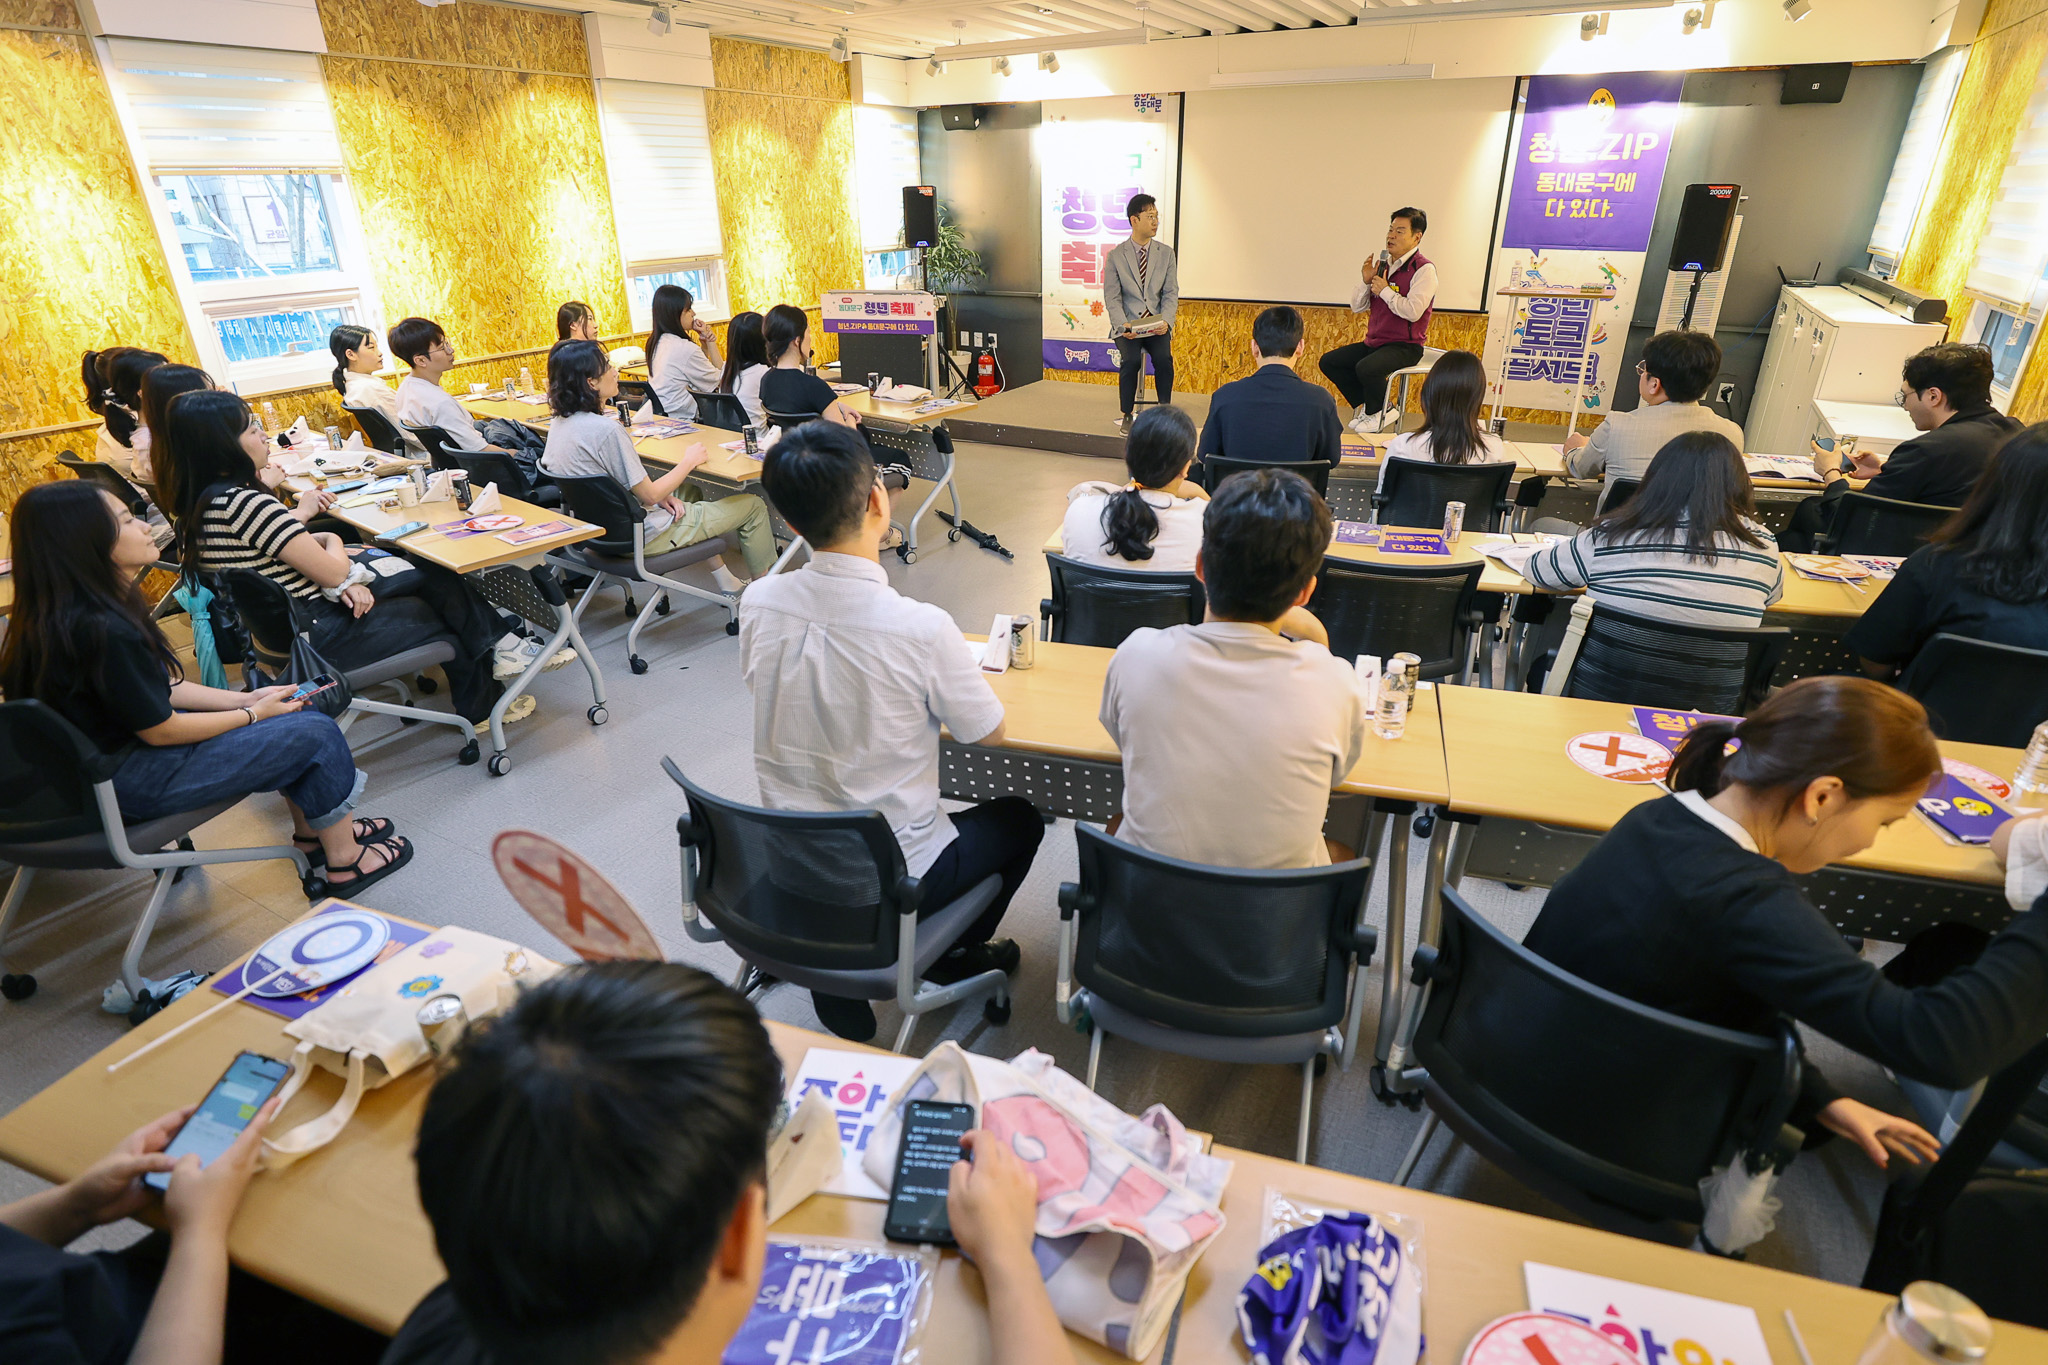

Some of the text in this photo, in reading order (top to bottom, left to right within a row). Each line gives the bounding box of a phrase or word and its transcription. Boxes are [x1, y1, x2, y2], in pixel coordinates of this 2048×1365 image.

[1536, 172, 1637, 193] 동대문구에
[1544, 198, 1614, 218] 다 있다.
[864, 301, 889, 316] 청년
[890, 302, 916, 316] 축제
[898, 323, 905, 331] 다
[1521, 317, 1587, 349] 토크
